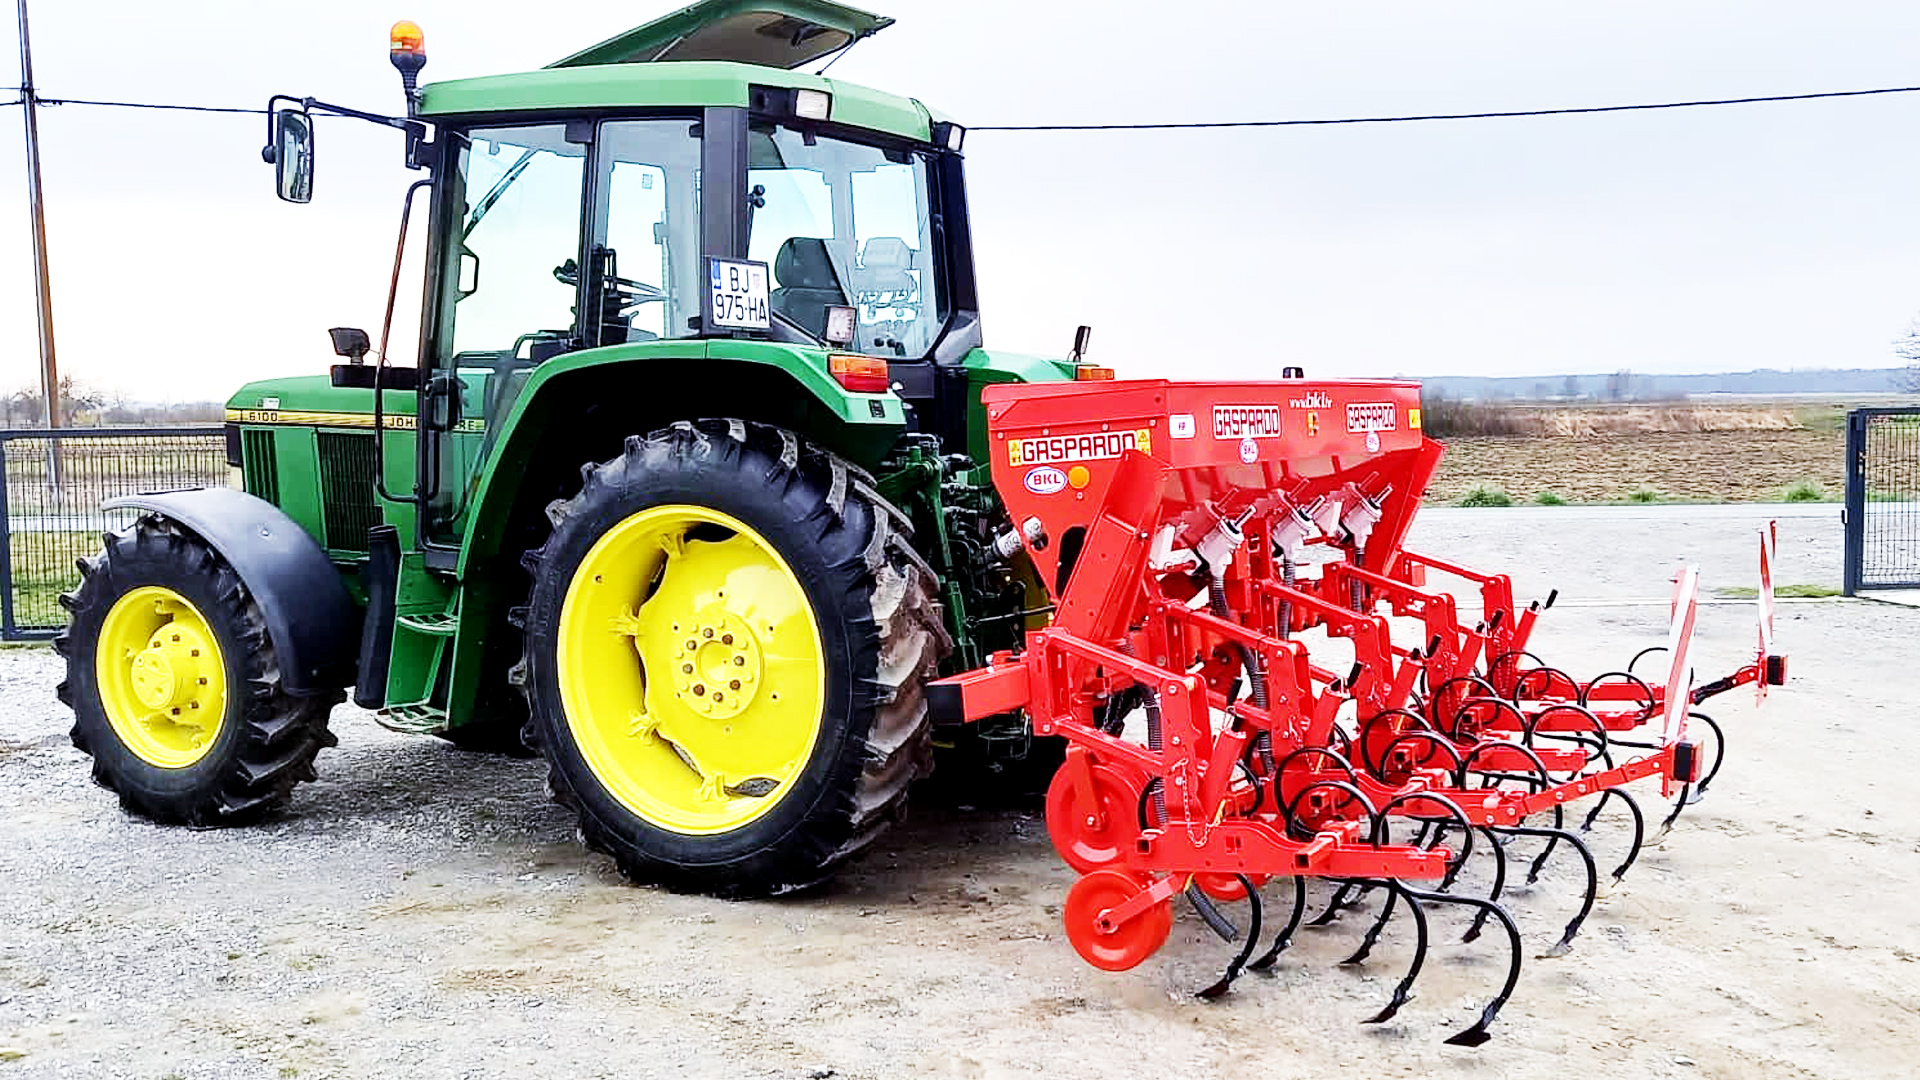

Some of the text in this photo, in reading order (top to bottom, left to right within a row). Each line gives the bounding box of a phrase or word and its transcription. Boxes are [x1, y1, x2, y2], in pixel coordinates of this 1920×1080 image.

[730, 266, 750, 293] BJ
[249, 412, 278, 422] 6100
[1214, 408, 1279, 436] GASPARDO
[1348, 405, 1395, 429] GASPARDO
[1022, 432, 1136, 463] GASPARDO
[1033, 473, 1062, 486] BKL
